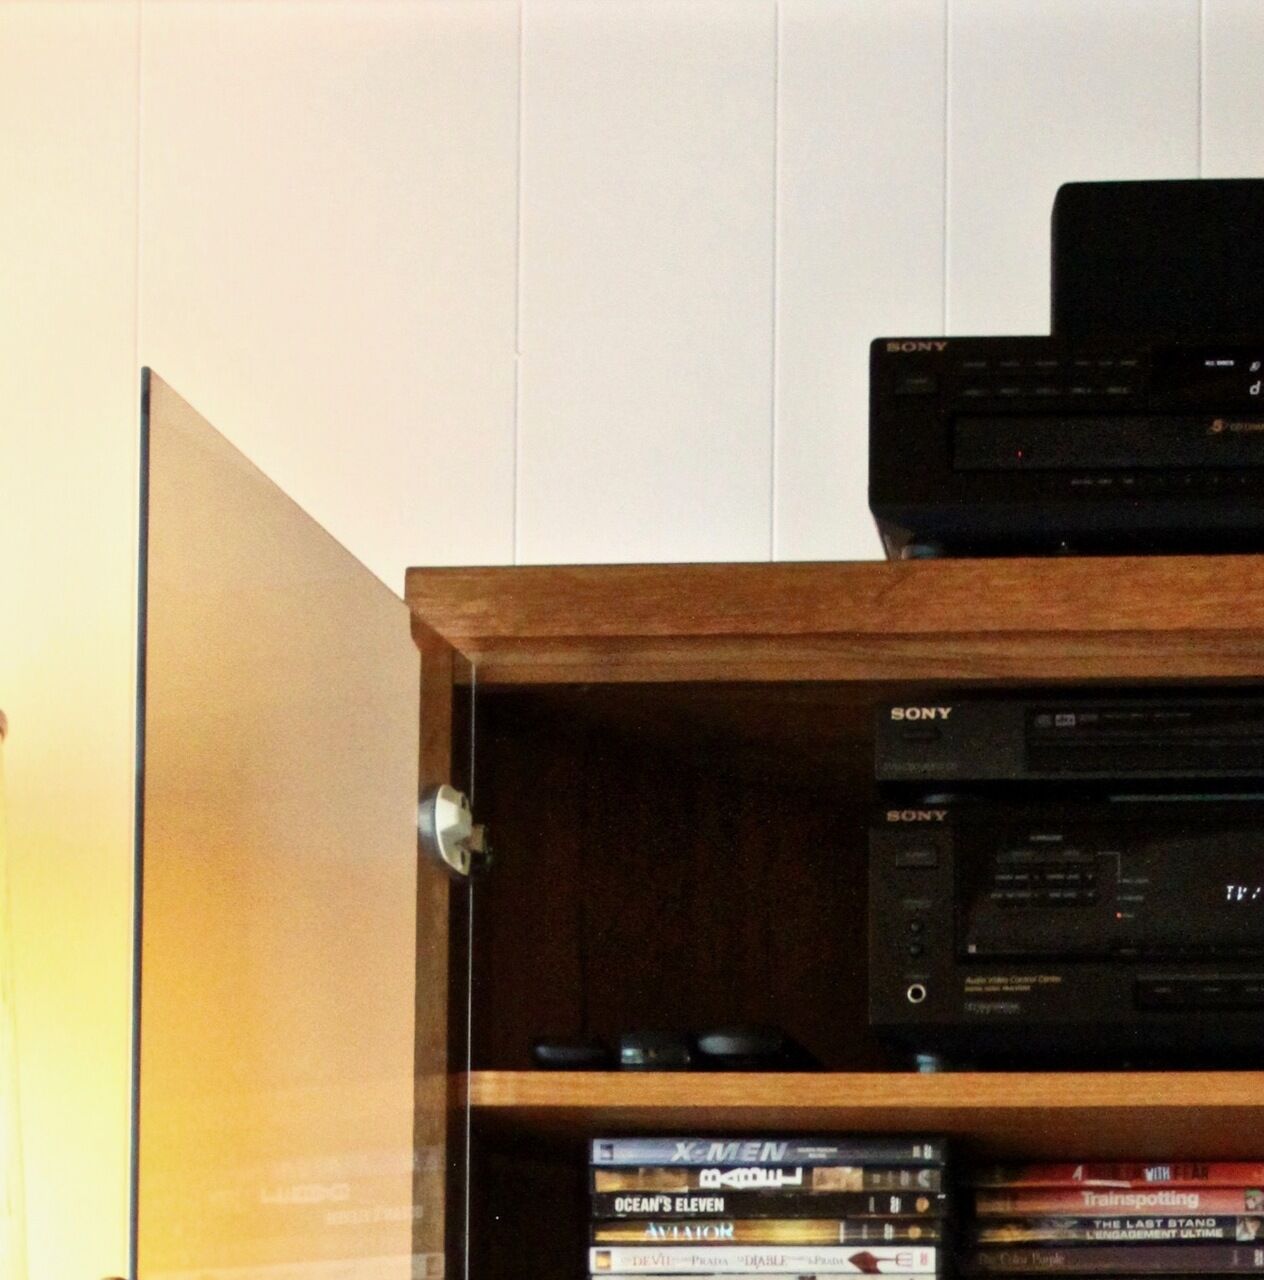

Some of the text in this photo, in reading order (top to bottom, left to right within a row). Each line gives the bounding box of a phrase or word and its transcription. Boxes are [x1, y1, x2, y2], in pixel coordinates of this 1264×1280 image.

[886, 342, 948, 353] SONY
[890, 707, 952, 720] SONY
[886, 810, 948, 822] SONY
[671, 1142, 788, 1163] X-MEN
[699, 1167, 802, 1188] BABEL
[614, 1197, 724, 1213] OCEAN'S ELEVEN
[1082, 1190, 1200, 1209] Trainspotting
[1094, 1218, 1216, 1229] THE LAST STAND
[646, 1222, 734, 1240] AVIATOR
[1086, 1228, 1223, 1240] L'ENGAGEMENT ULTIME
